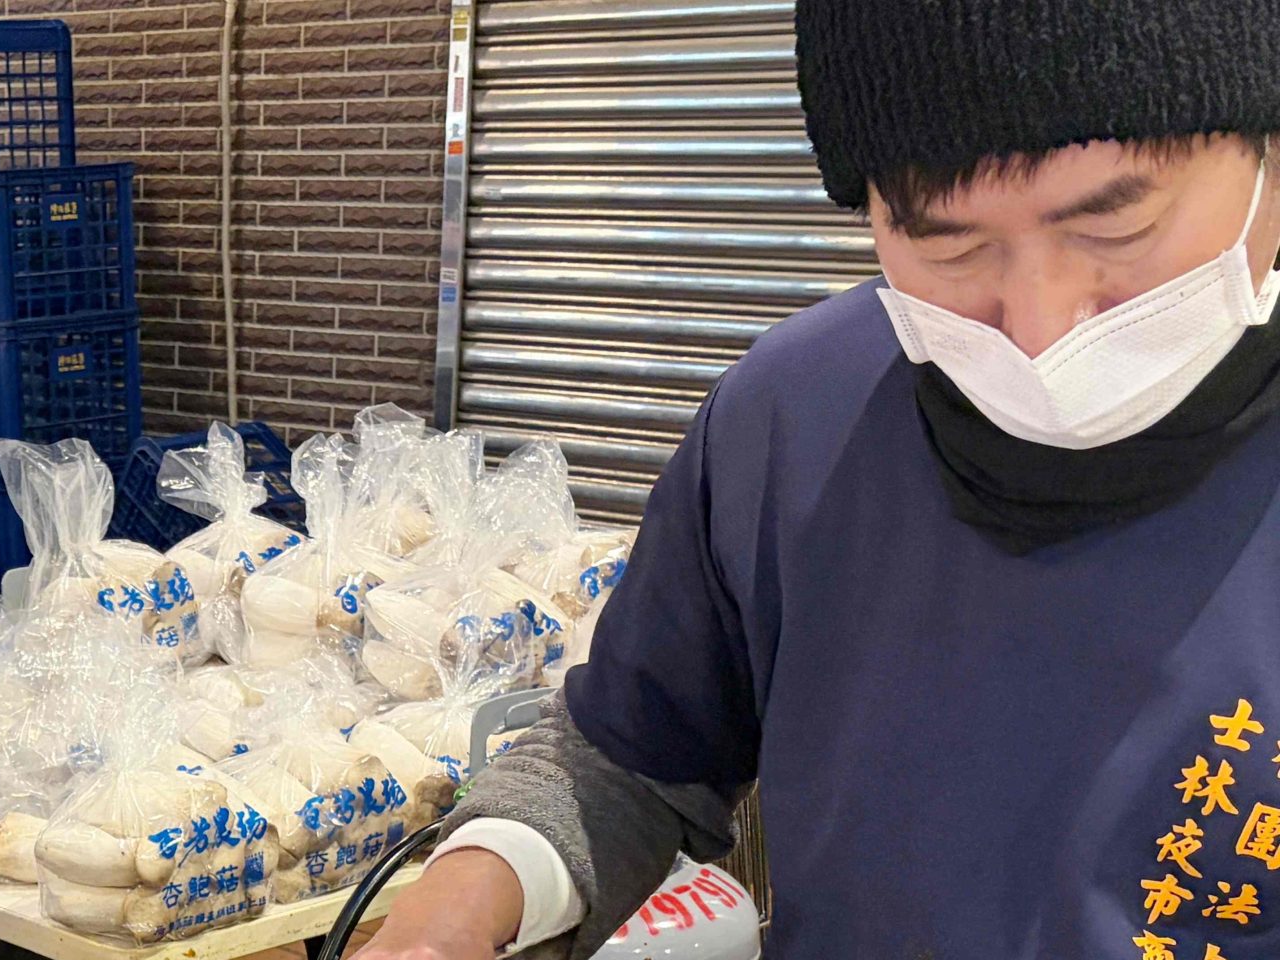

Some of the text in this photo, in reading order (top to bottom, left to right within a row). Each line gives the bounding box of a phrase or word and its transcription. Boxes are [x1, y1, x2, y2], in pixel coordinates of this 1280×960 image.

[306, 832, 384, 878] 杏鮑菇
[161, 864, 239, 908] 杏鮑菇
